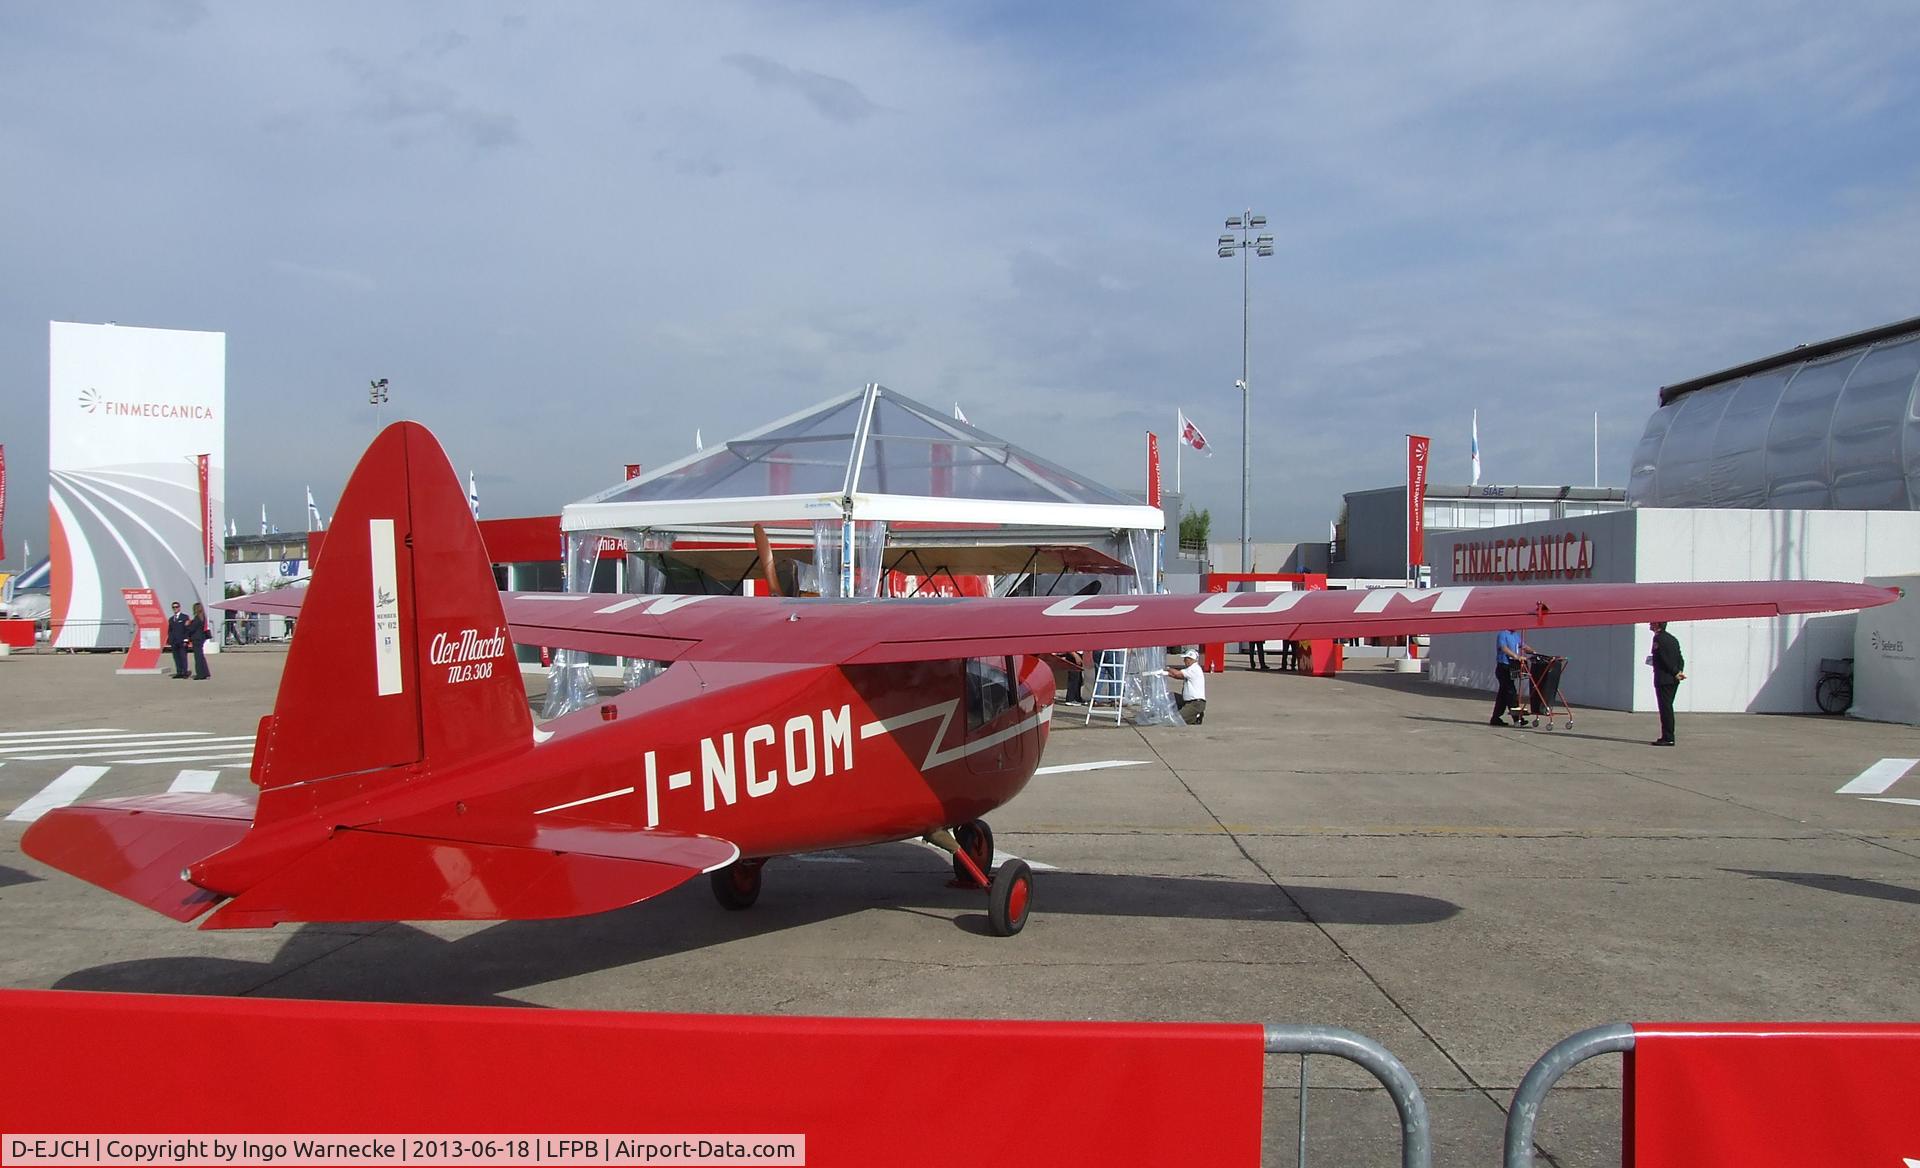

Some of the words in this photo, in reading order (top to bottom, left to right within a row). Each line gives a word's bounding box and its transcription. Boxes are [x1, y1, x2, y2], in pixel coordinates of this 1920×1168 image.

[105, 402, 213, 419] FINMECCANICA
[1483, 487, 1505, 496] SIAE
[1453, 531, 1592, 582] FINMECCANICA
[644, 704, 853, 828] I-NCOM
